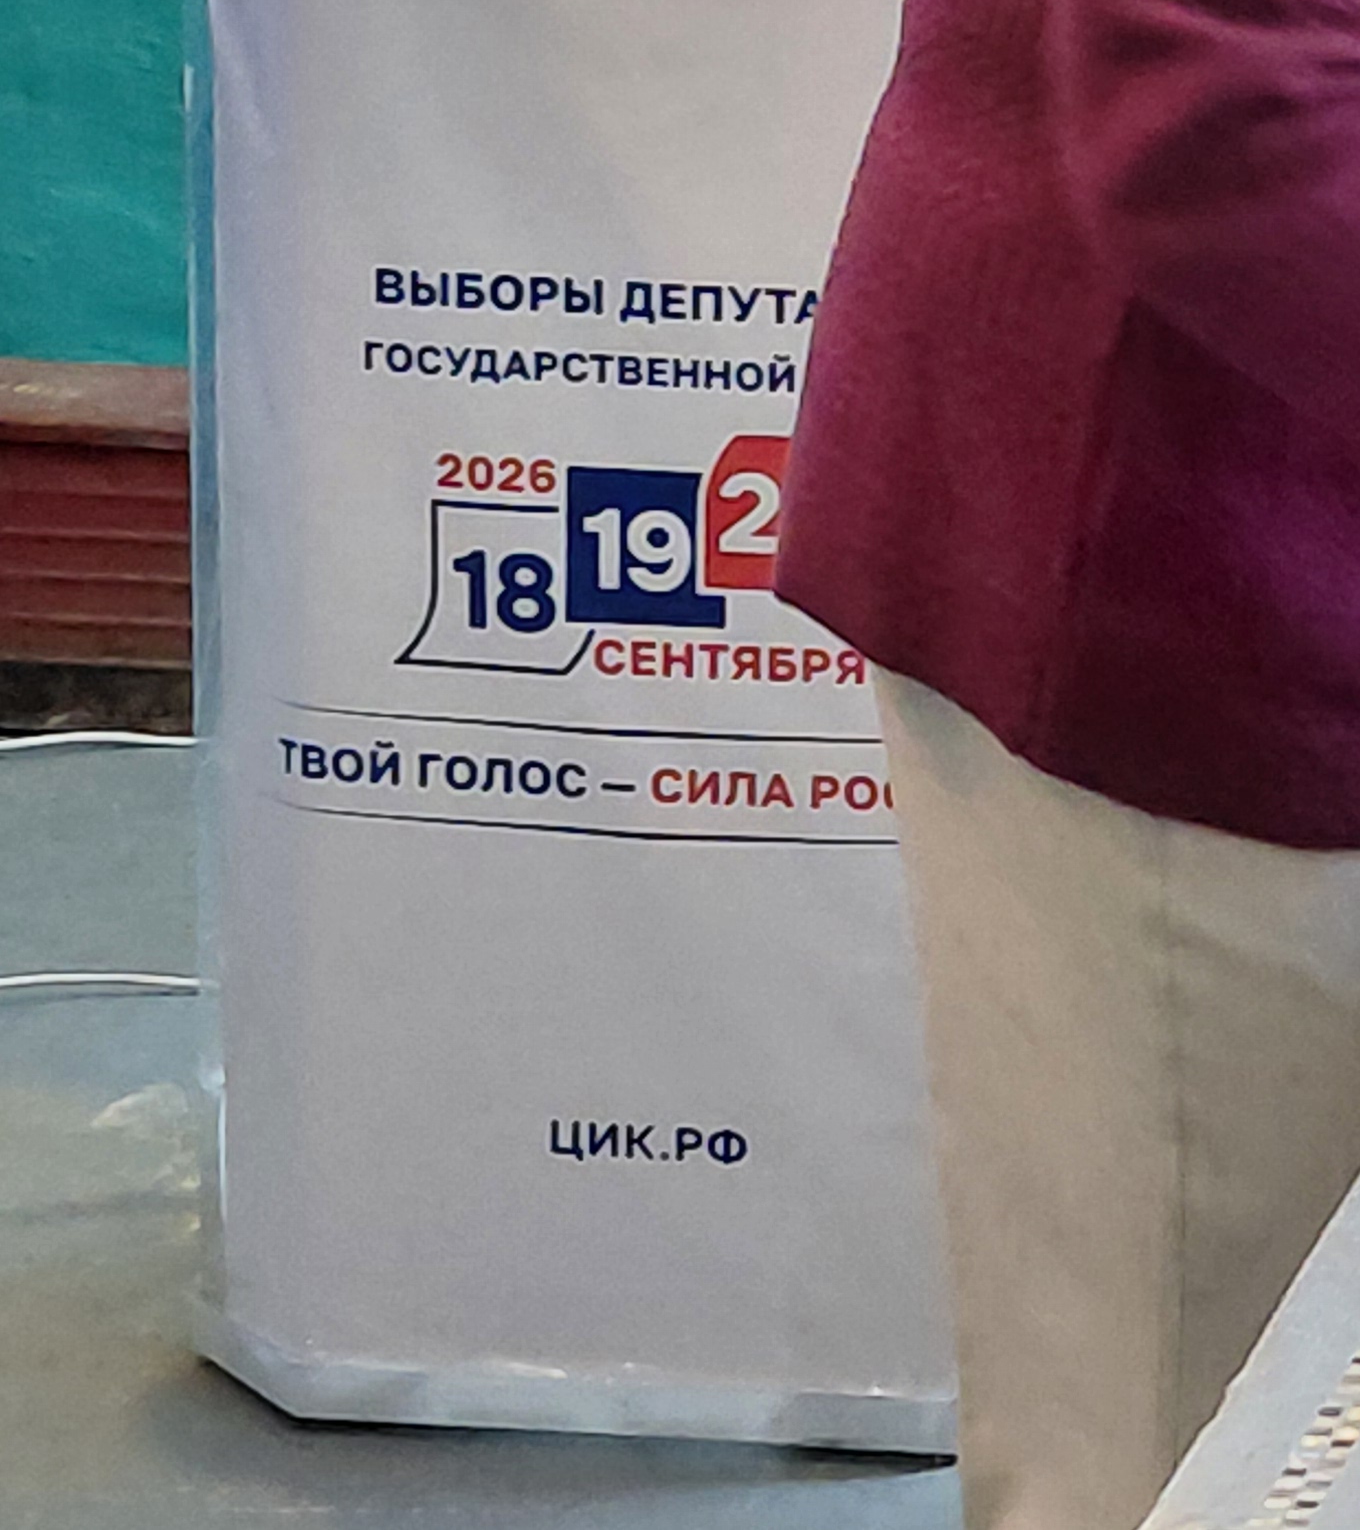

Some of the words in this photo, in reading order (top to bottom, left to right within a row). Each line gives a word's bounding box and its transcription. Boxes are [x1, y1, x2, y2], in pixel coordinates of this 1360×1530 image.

[374, 268, 604, 315] ВЫБОРЫ
[363, 341, 796, 392] ГОСУДАРСТВЕННОЙ
[436, 453, 556, 494] 2026
[453, 549, 557, 634] 18
[583, 507, 692, 593] 19
[593, 639, 866, 685] СЕНТЯБРЯ
[278, 737, 400, 787] ТВОЙ
[418, 753, 587, 799] ГОЛОС
[650, 768, 794, 808] СИЛА
[550, 1118, 748, 1165] ЦИК.РФ
